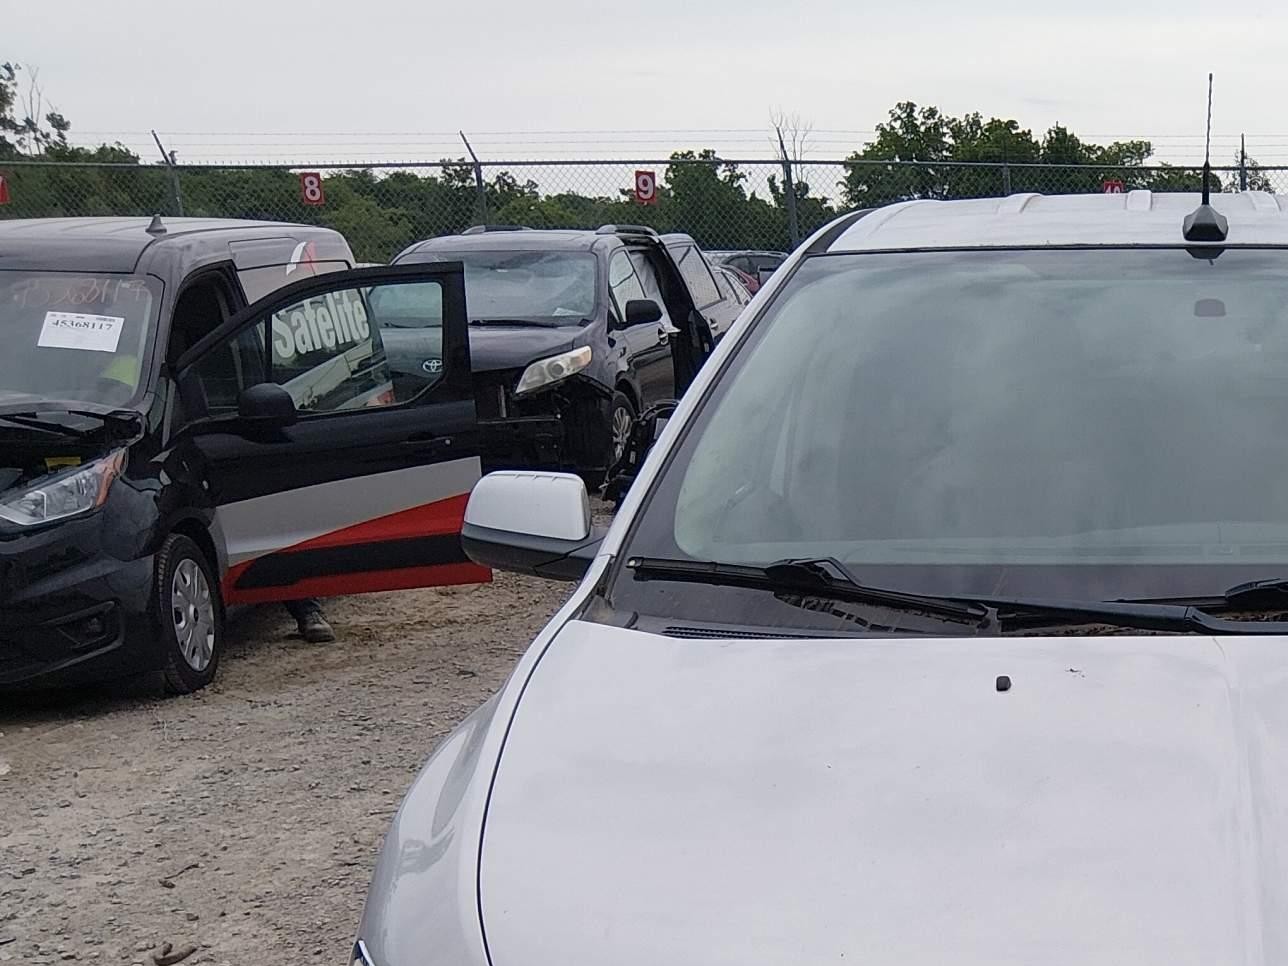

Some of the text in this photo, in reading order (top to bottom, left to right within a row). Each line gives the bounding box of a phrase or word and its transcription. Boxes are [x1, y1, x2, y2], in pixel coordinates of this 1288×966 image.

[304, 175, 321, 201] 8
[637, 174, 654, 200] 9
[271, 288, 370, 358] Safelite
